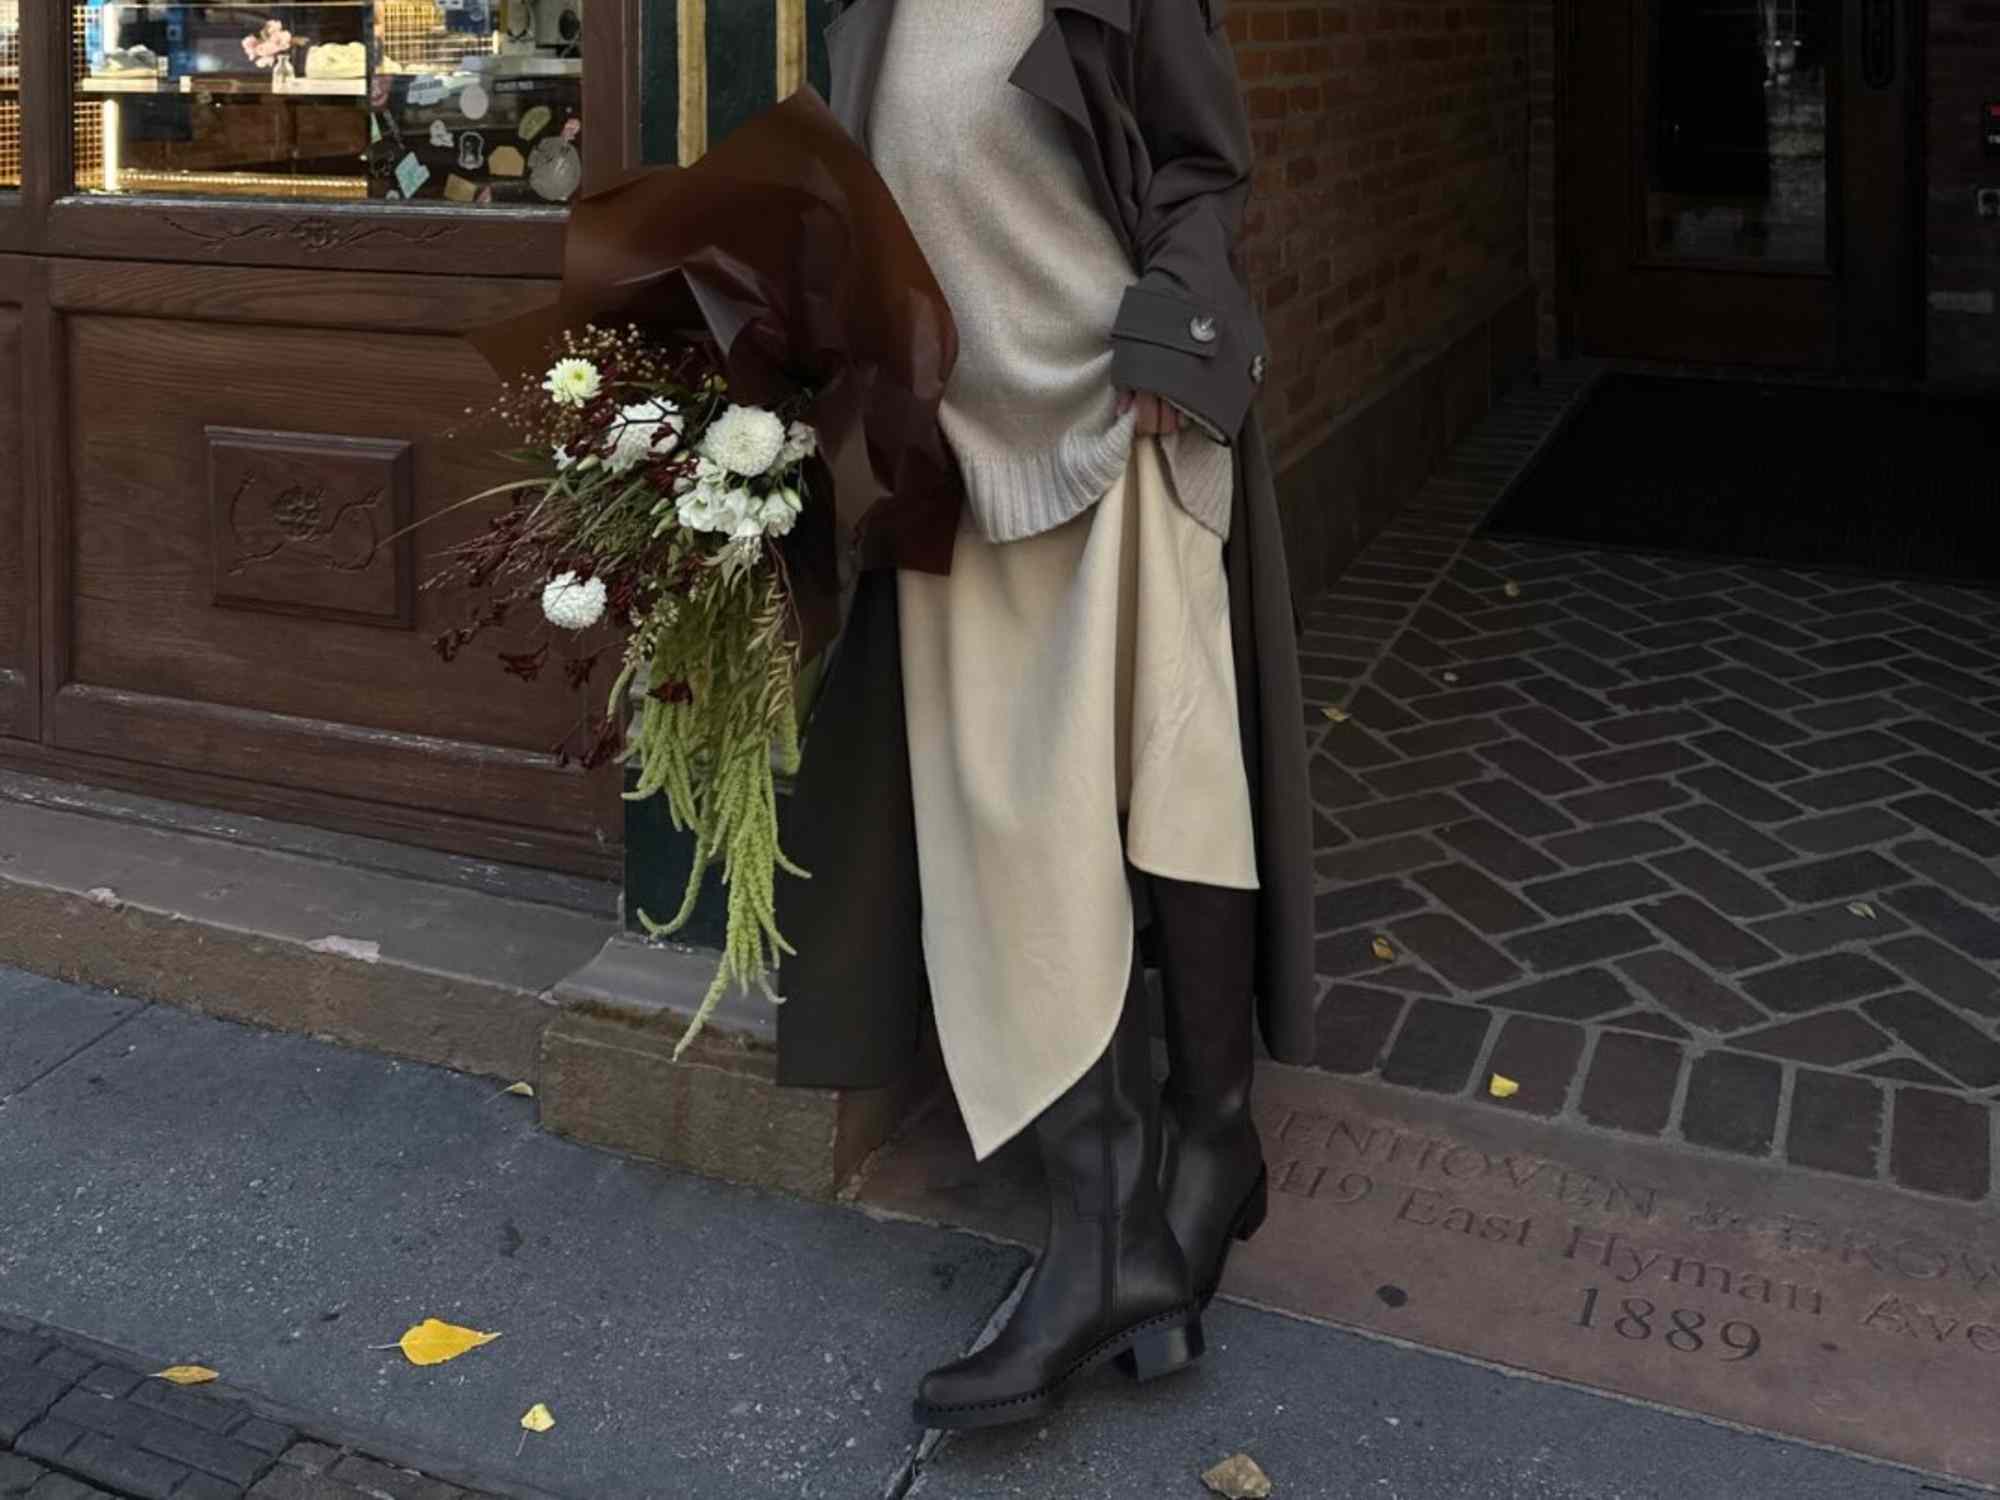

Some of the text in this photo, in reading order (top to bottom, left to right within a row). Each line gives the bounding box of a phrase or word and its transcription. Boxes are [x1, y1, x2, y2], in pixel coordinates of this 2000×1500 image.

[1393, 1182, 1543, 1248] East
[1562, 1225, 1826, 1316] Hyman
[1568, 1286, 1762, 1362] 1889
